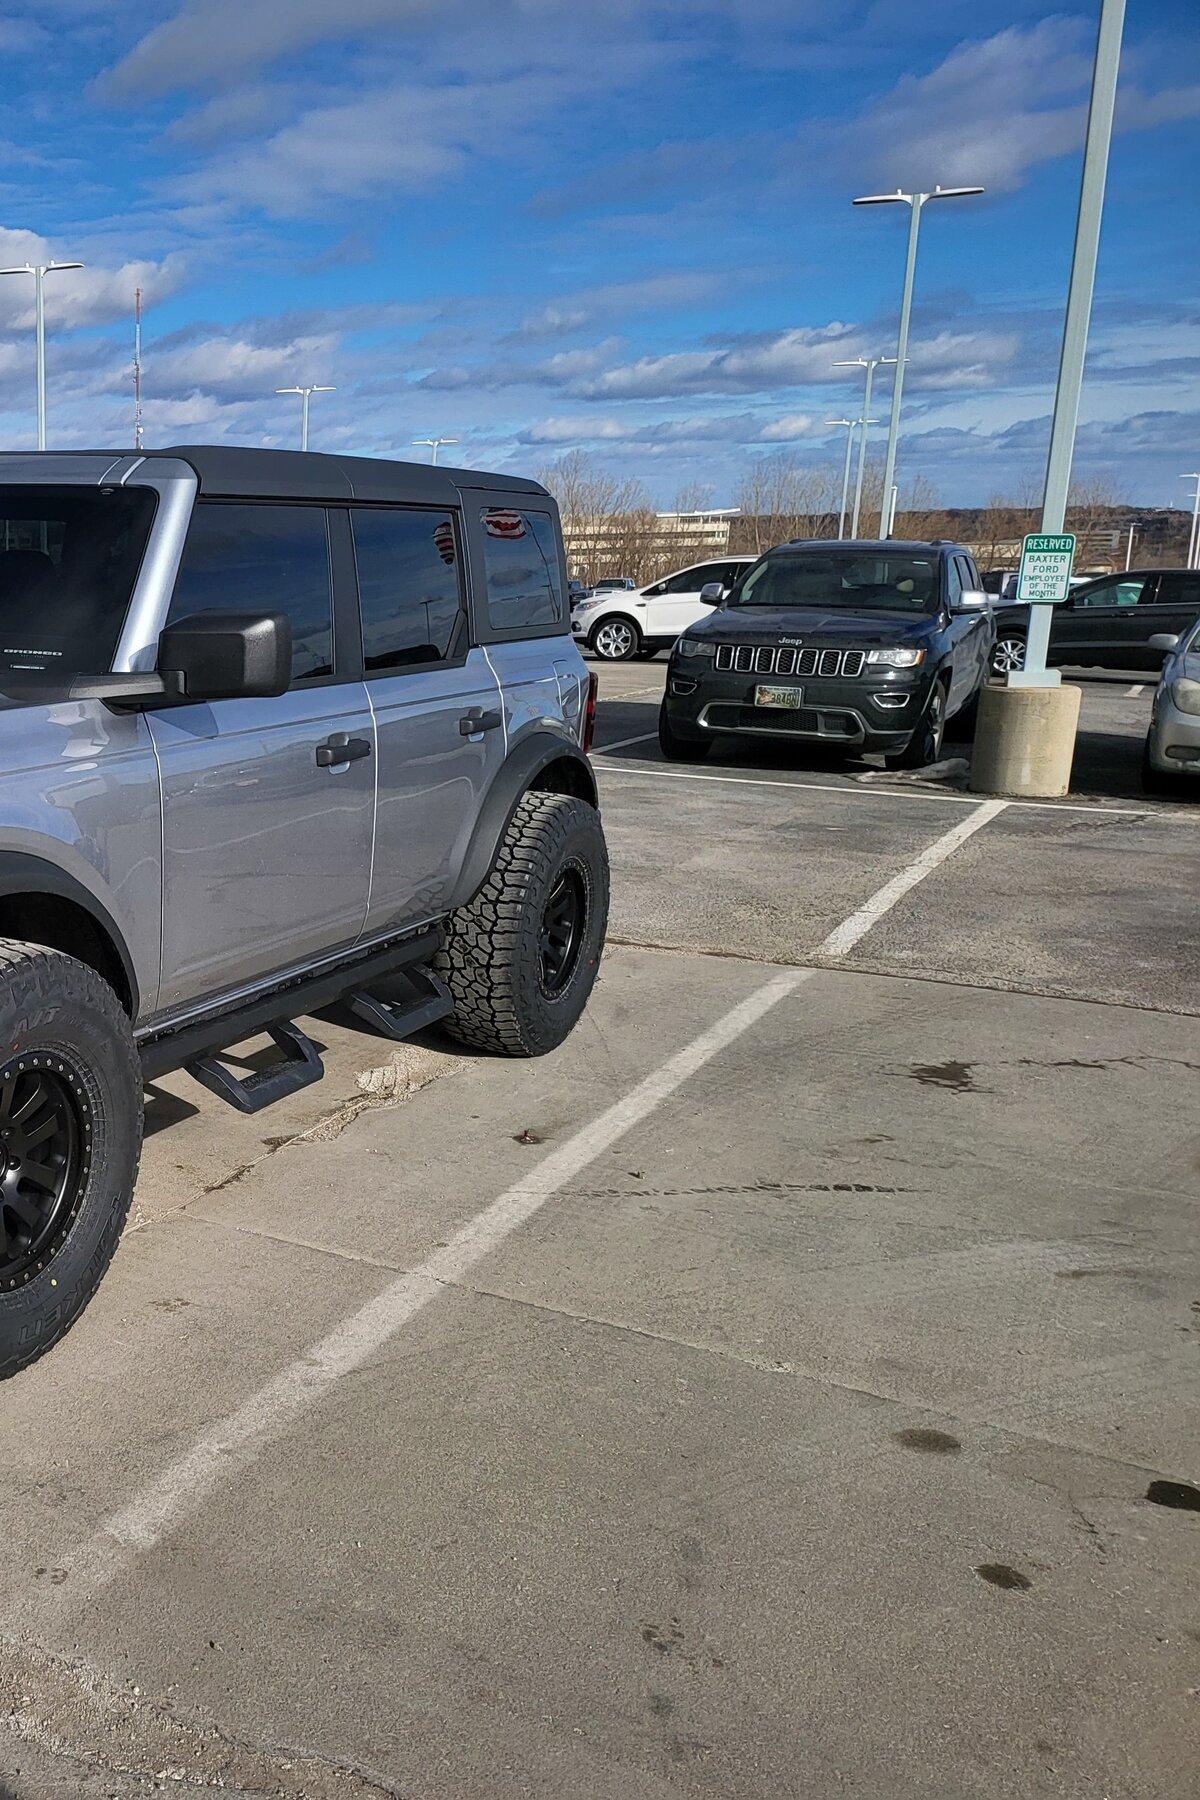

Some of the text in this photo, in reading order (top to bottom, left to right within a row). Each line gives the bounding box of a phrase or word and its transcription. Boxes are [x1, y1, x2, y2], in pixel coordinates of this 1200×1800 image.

[1027, 538, 1072, 550] RESERVED
[1028, 555, 1067, 563] BAXTER
[1032, 565, 1059, 573] FORD
[778, 636, 803, 645] Jeep
